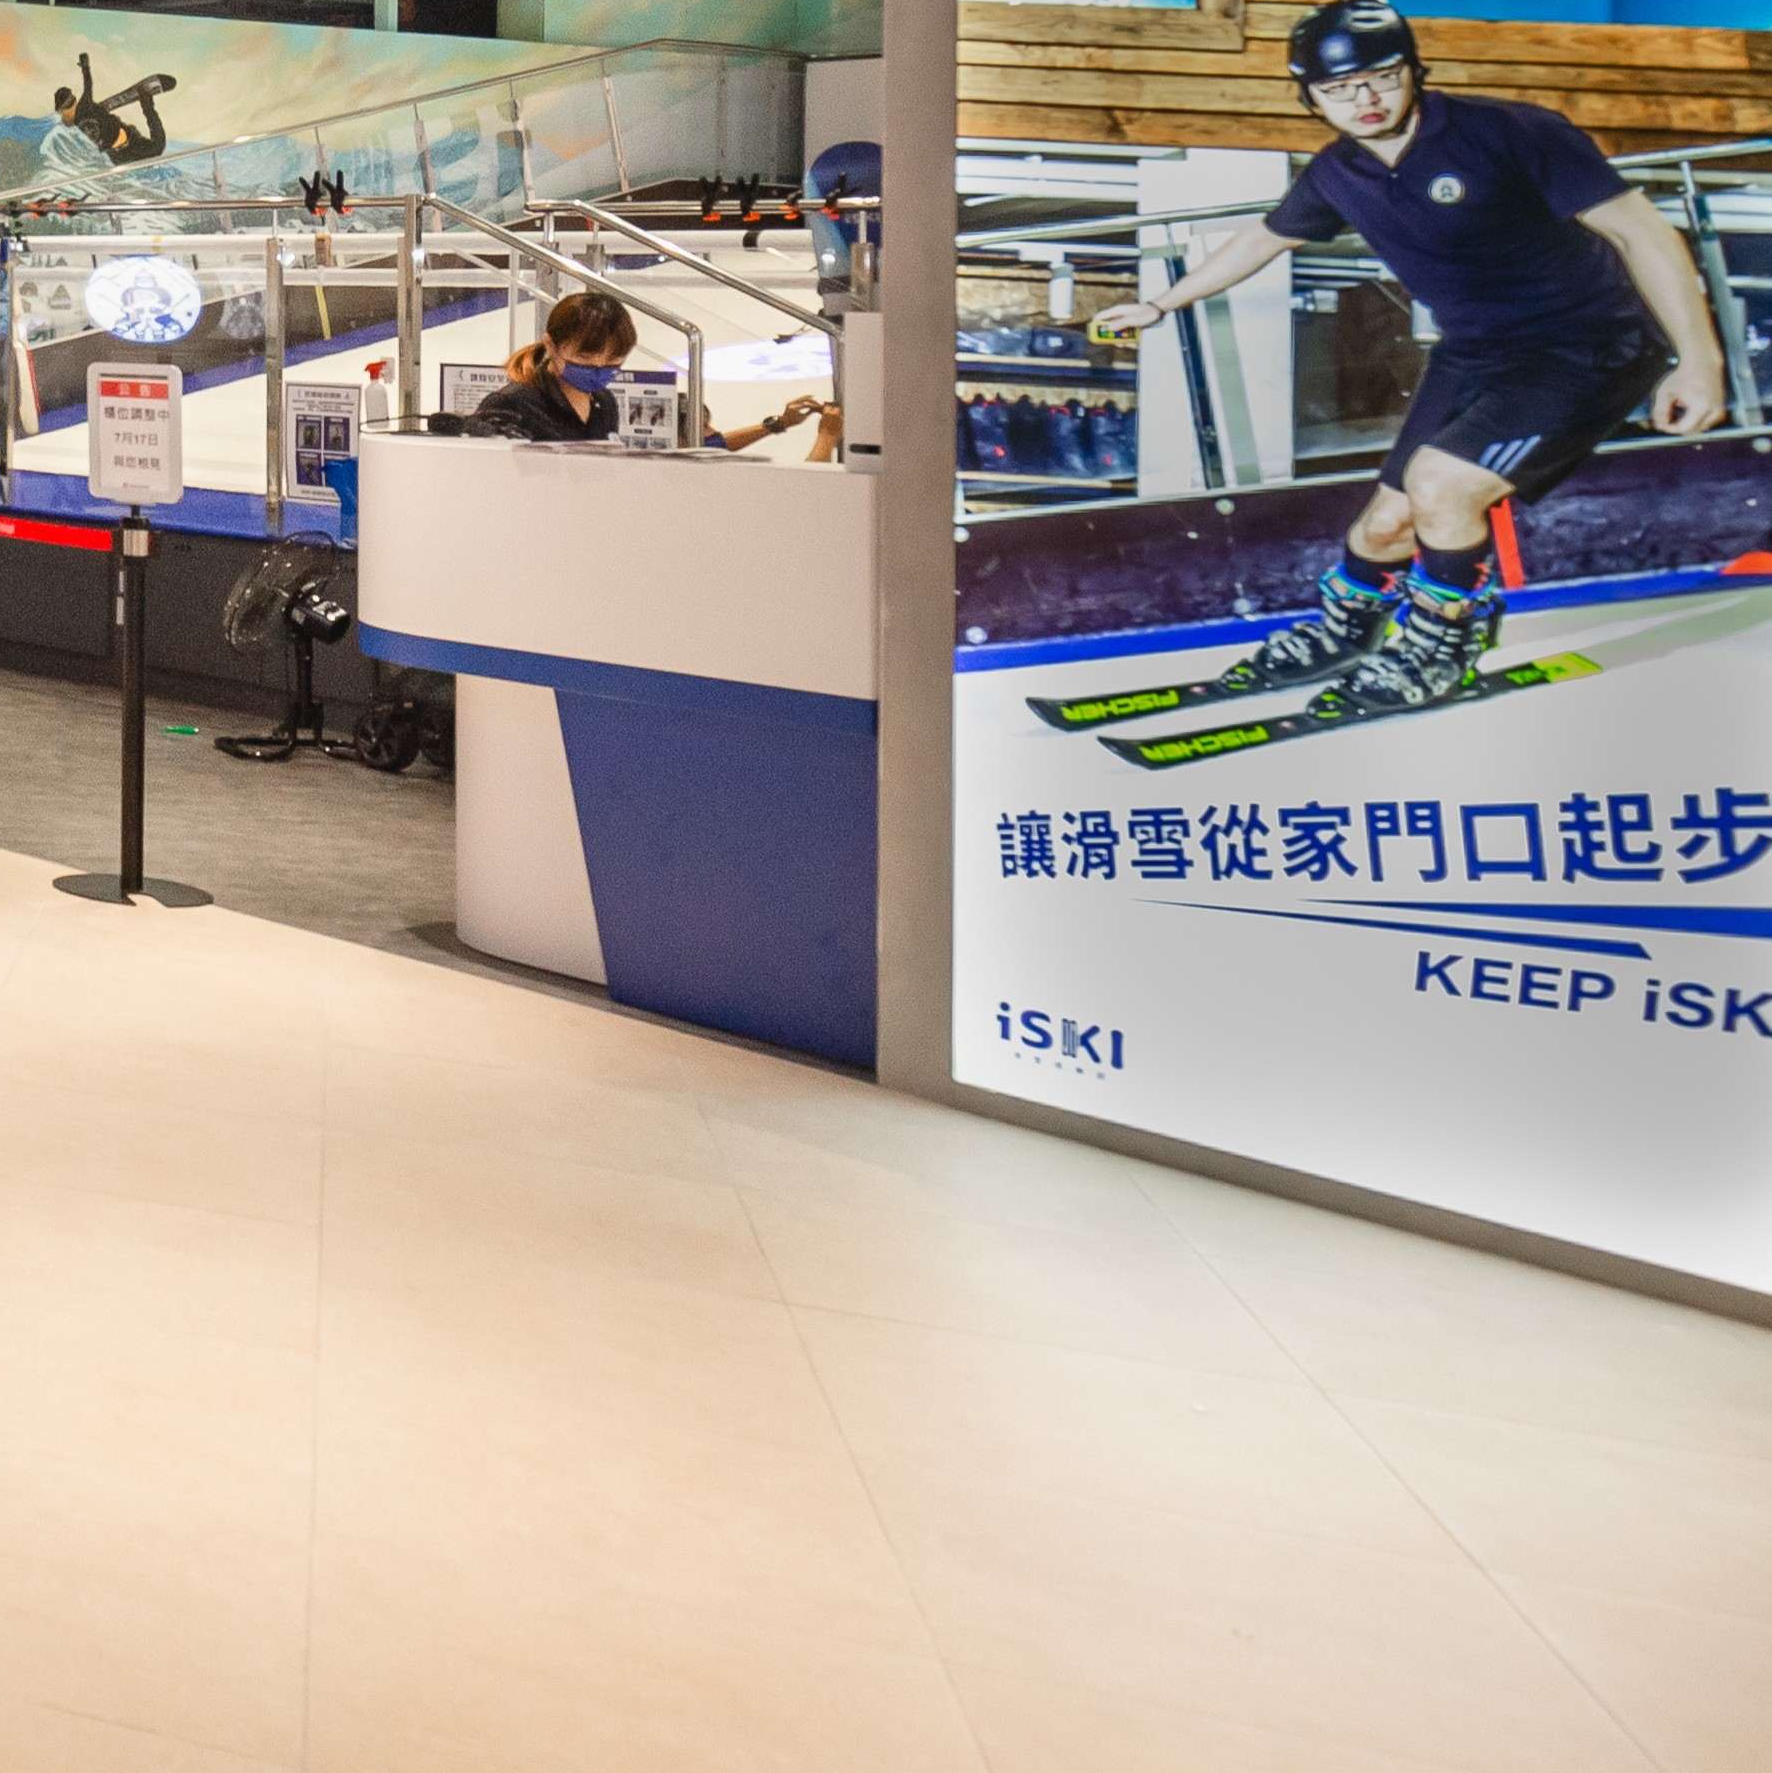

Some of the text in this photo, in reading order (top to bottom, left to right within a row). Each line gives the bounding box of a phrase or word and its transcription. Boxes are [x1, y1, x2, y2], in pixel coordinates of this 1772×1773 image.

[114, 432, 159, 447] 7月17日
[1061, 689, 1180, 723] FISCHER
[1139, 724, 1270, 762] FISCHER
[996, 787, 1772, 885] 讓滑雪從家門口起步
[1414, 950, 1617, 1015] KEEP
[995, 1001, 1124, 1070] iSKI
